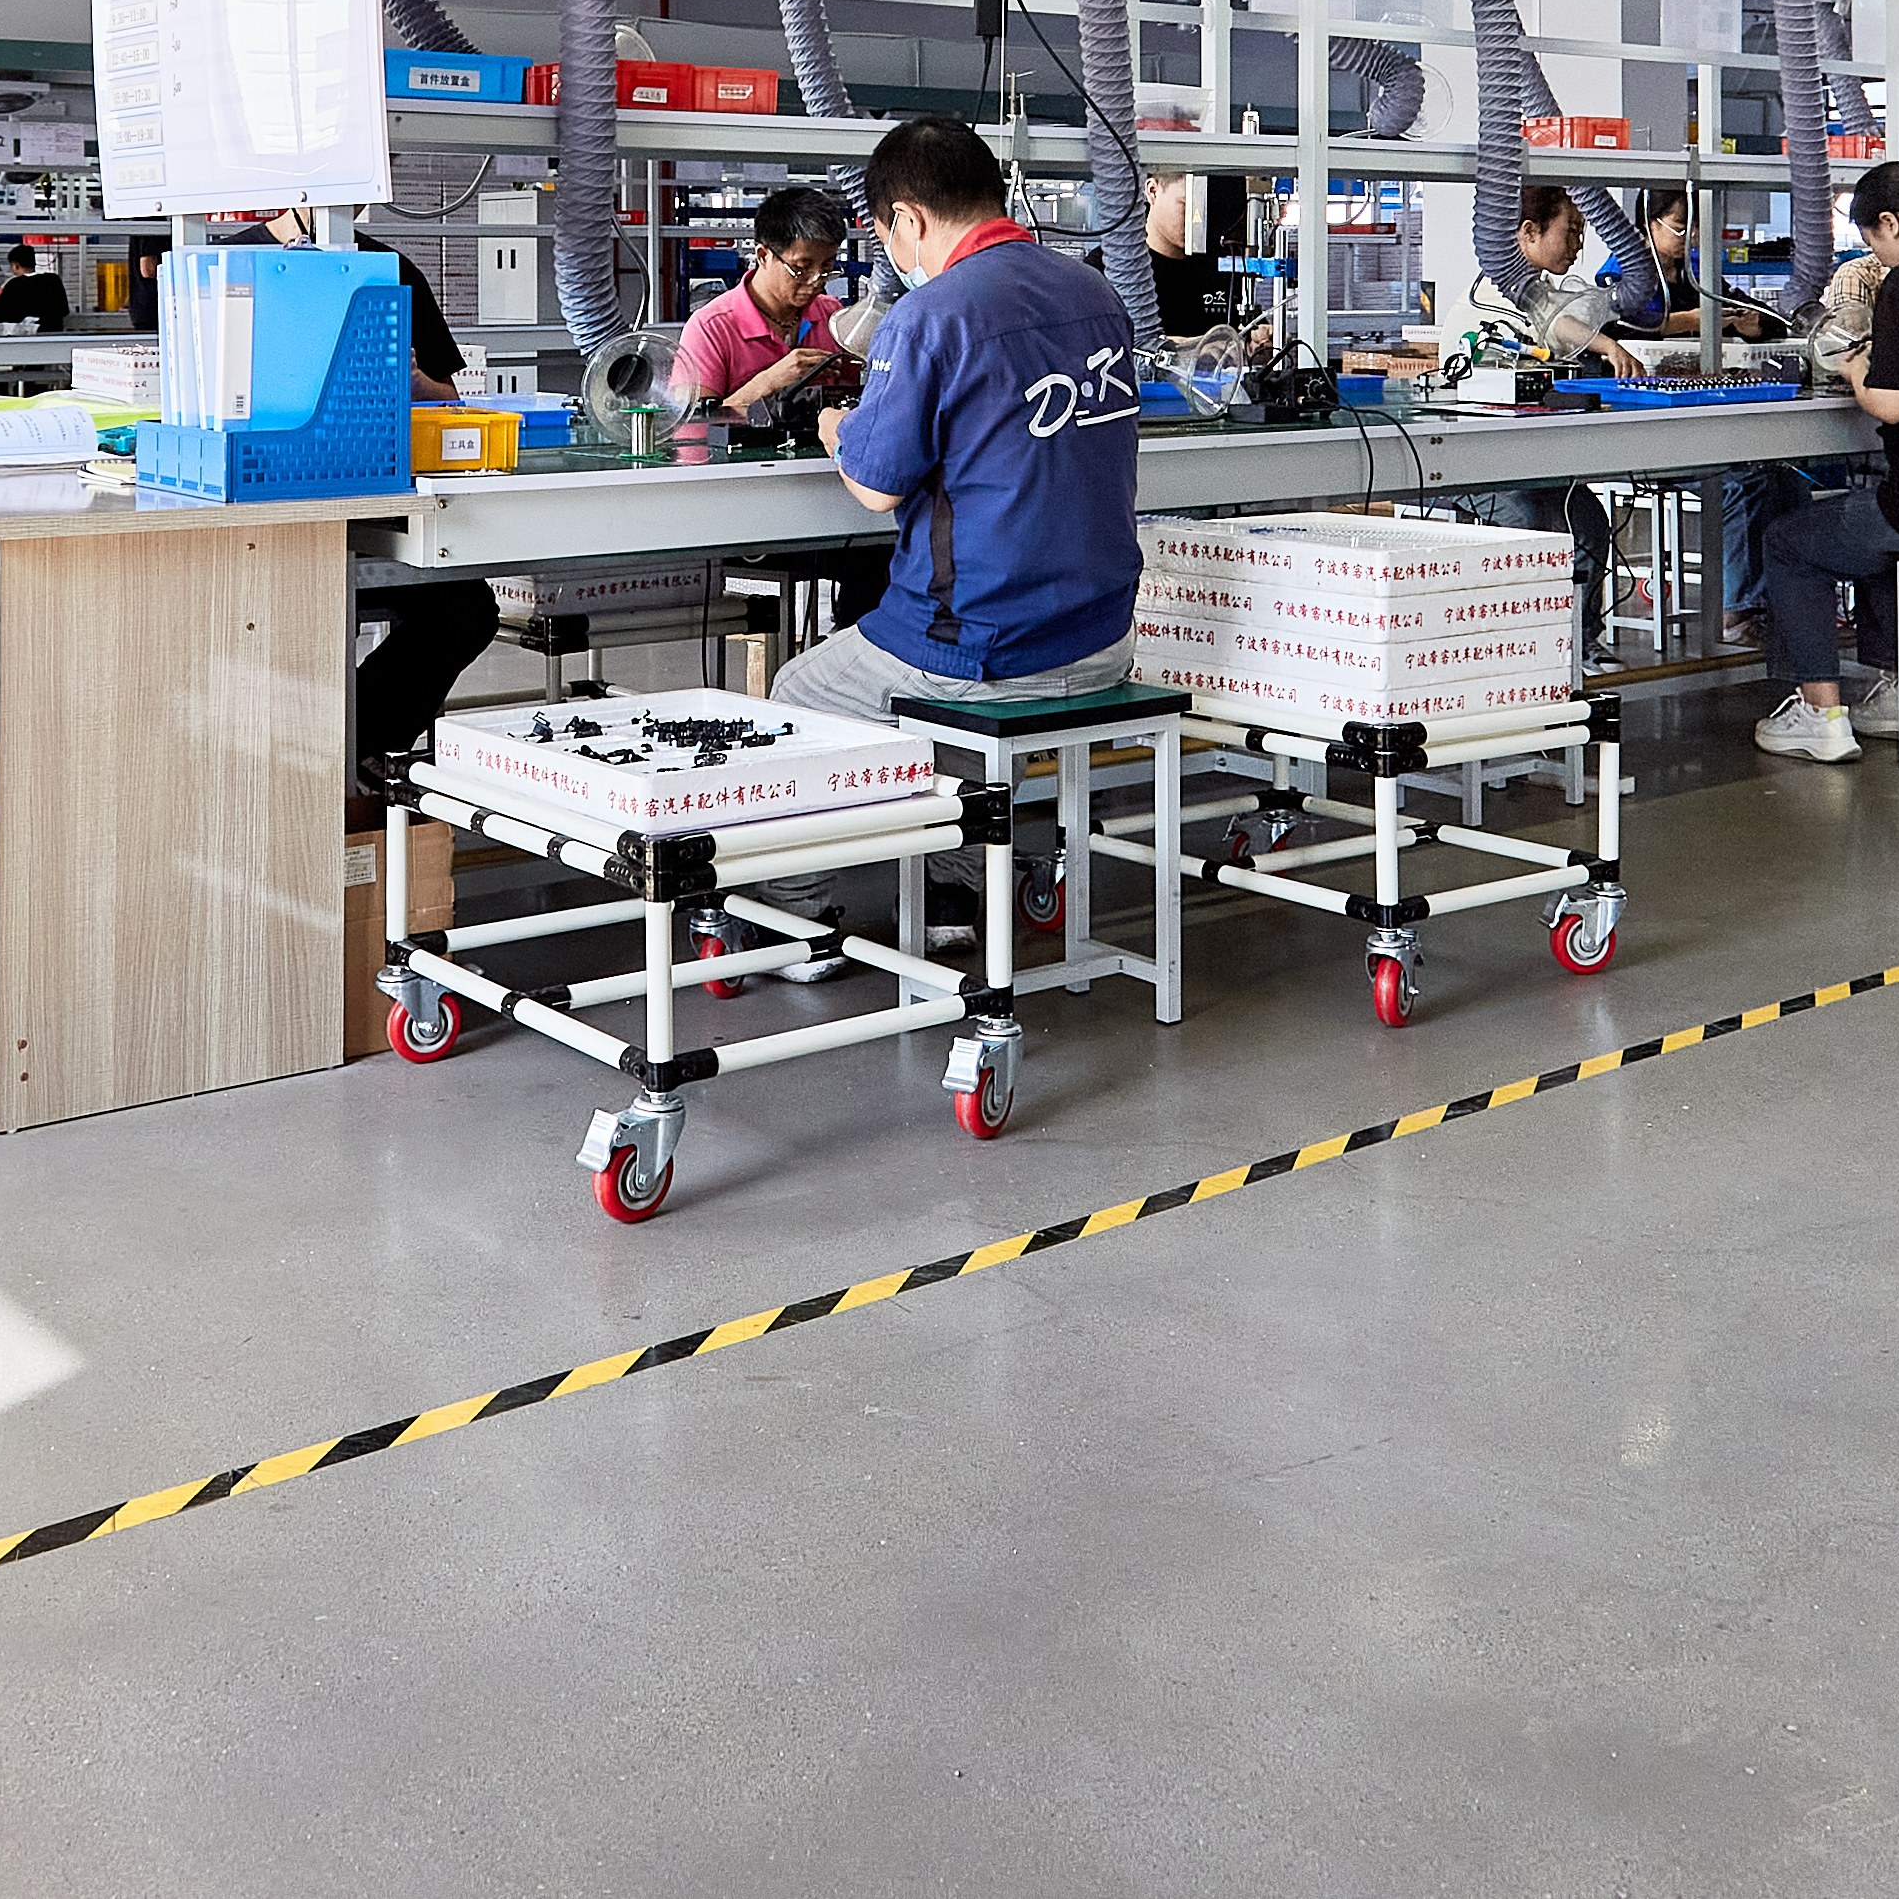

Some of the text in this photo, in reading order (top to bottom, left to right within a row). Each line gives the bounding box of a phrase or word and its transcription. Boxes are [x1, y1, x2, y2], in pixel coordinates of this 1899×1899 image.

[420, 73, 470, 88] 首件放置盒
[449, 440, 474, 450] 工具盒
[1157, 539, 1292, 570] 宁波帝客汽车配件有限公司
[1314, 557, 1461, 582] 宁波帝客汽车配件有限公司
[1274, 600, 1423, 631] 宁波帝客汽车配件有限公司
[1236, 633, 1381, 672] 宁波帝客汽车配件有限公司
[1406, 641, 1537, 669] 宁波帝客汽车配件有限公司
[1161, 669, 1297, 703] 宁波帝客汽车配件有限公司
[1320, 691, 1464, 719] 宁波帝客汽车配件有限公司
[476, 749, 590, 800] 宁波帝客汽车配件有限公司
[608, 779, 797, 817] 宁波帝客汽车配件有限公司
